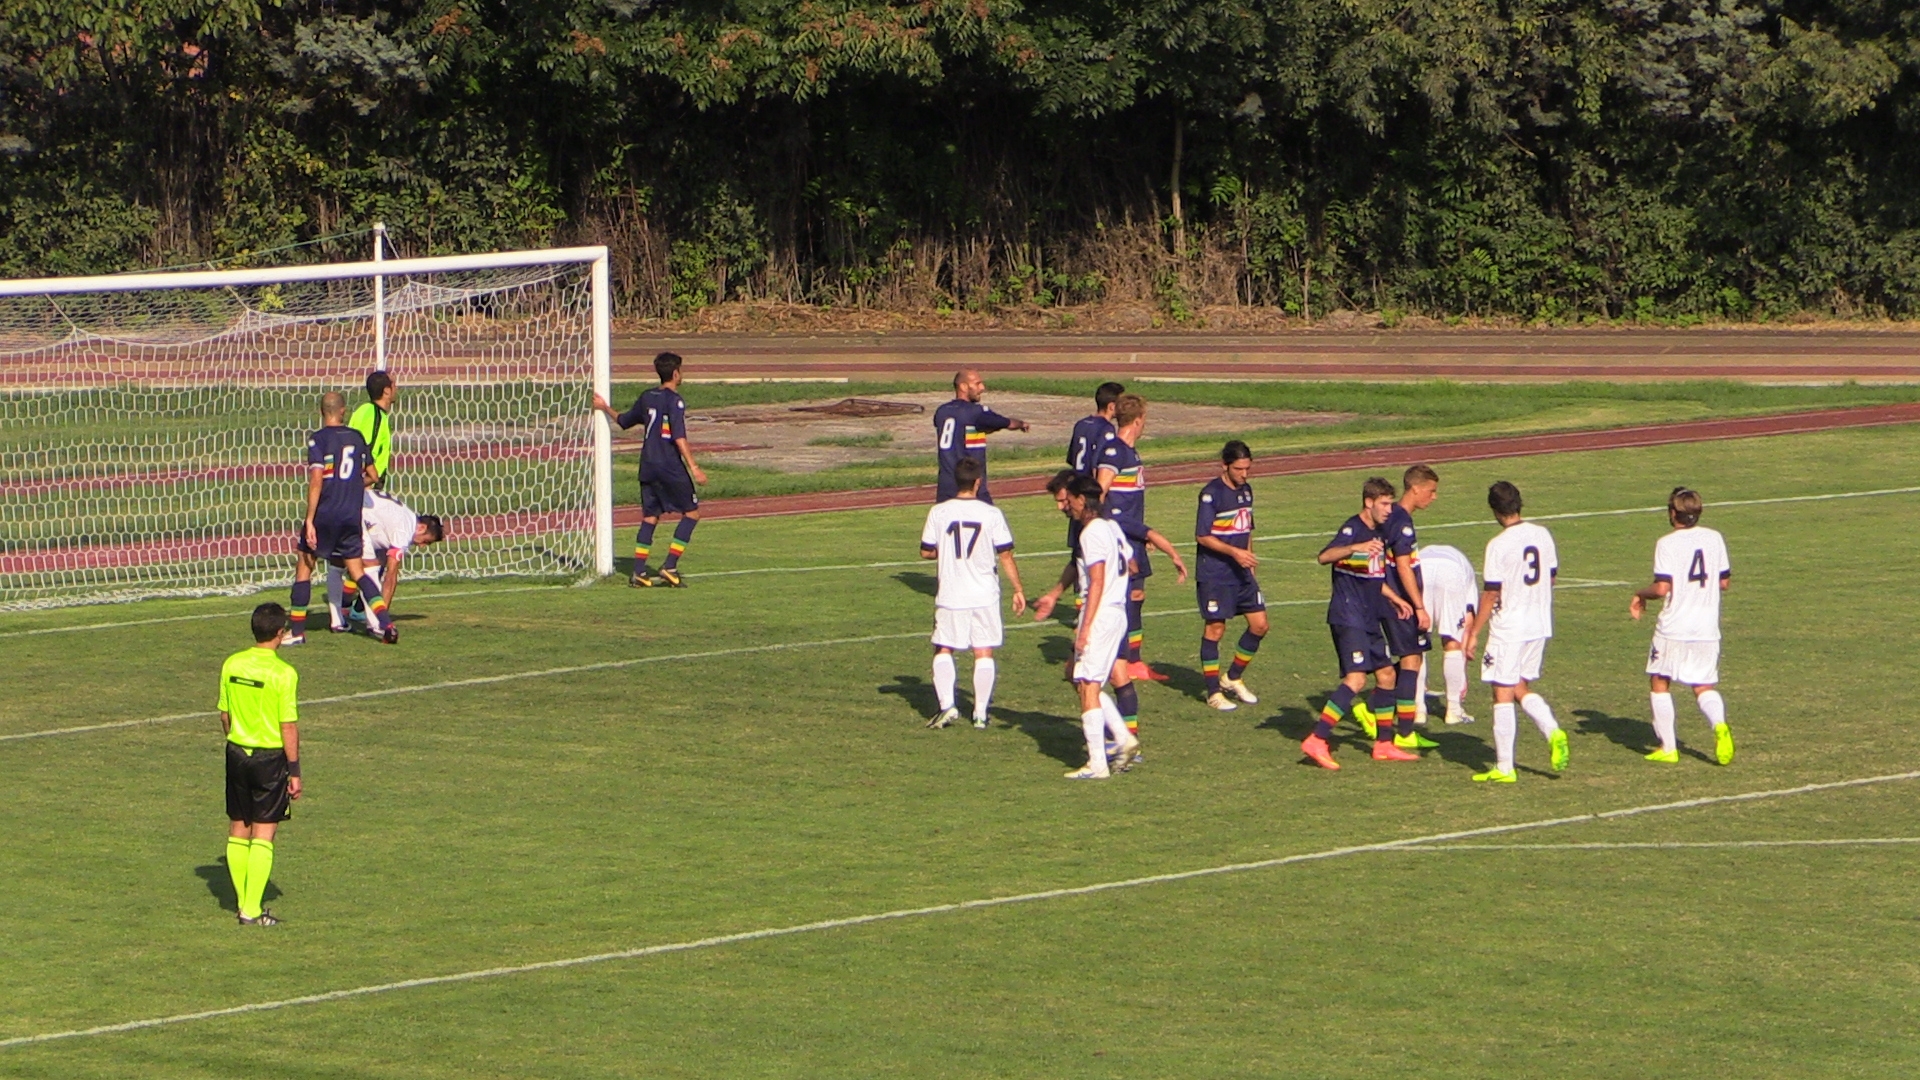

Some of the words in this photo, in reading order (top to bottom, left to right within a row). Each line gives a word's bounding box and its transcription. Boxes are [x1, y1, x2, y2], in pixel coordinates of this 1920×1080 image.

[645, 408, 657, 440] 7
[939, 417, 956, 450] 8
[339, 445, 355, 480] 6
[1076, 437, 1087, 471] 2
[946, 521, 982, 559] 17
[1523, 545, 1540, 586] 3
[1687, 548, 1708, 589] 4
